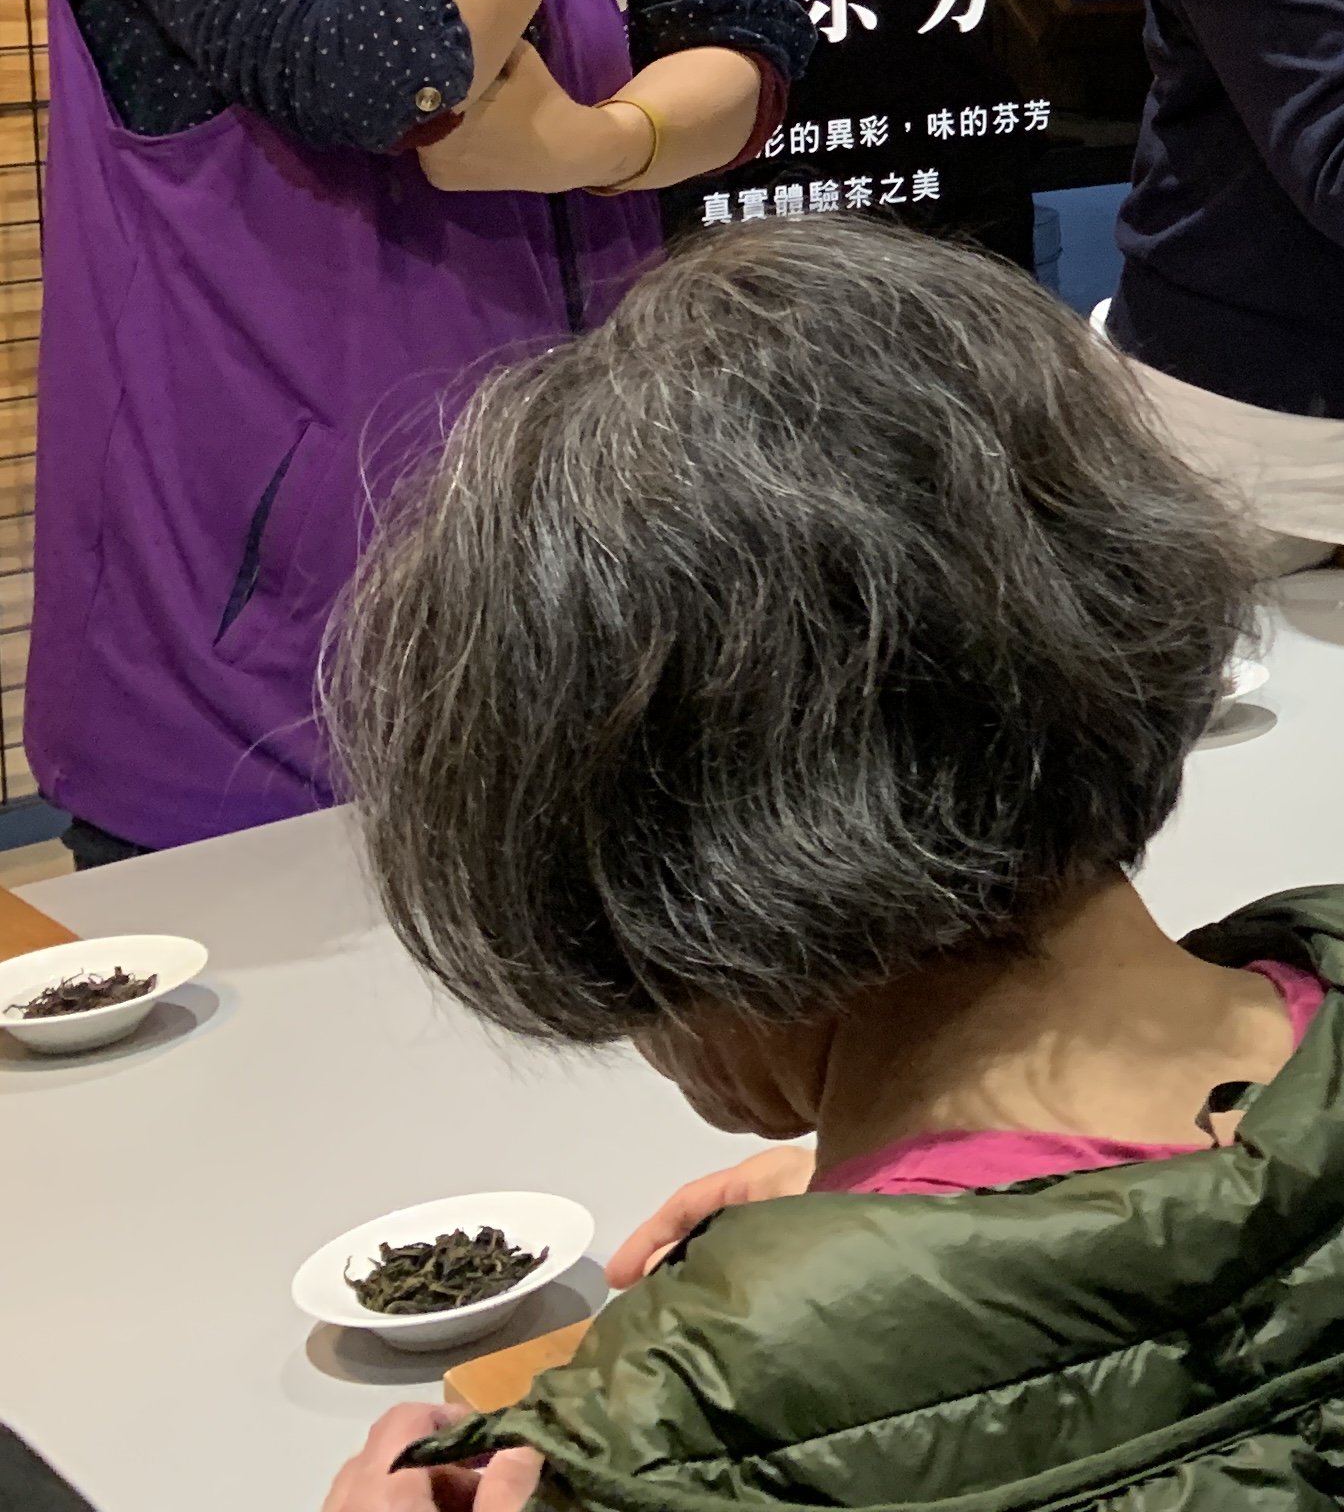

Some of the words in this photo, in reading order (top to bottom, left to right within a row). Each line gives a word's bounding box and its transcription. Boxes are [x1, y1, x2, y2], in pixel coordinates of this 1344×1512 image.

[702, 168, 941, 226] 真實體驗茶之美
